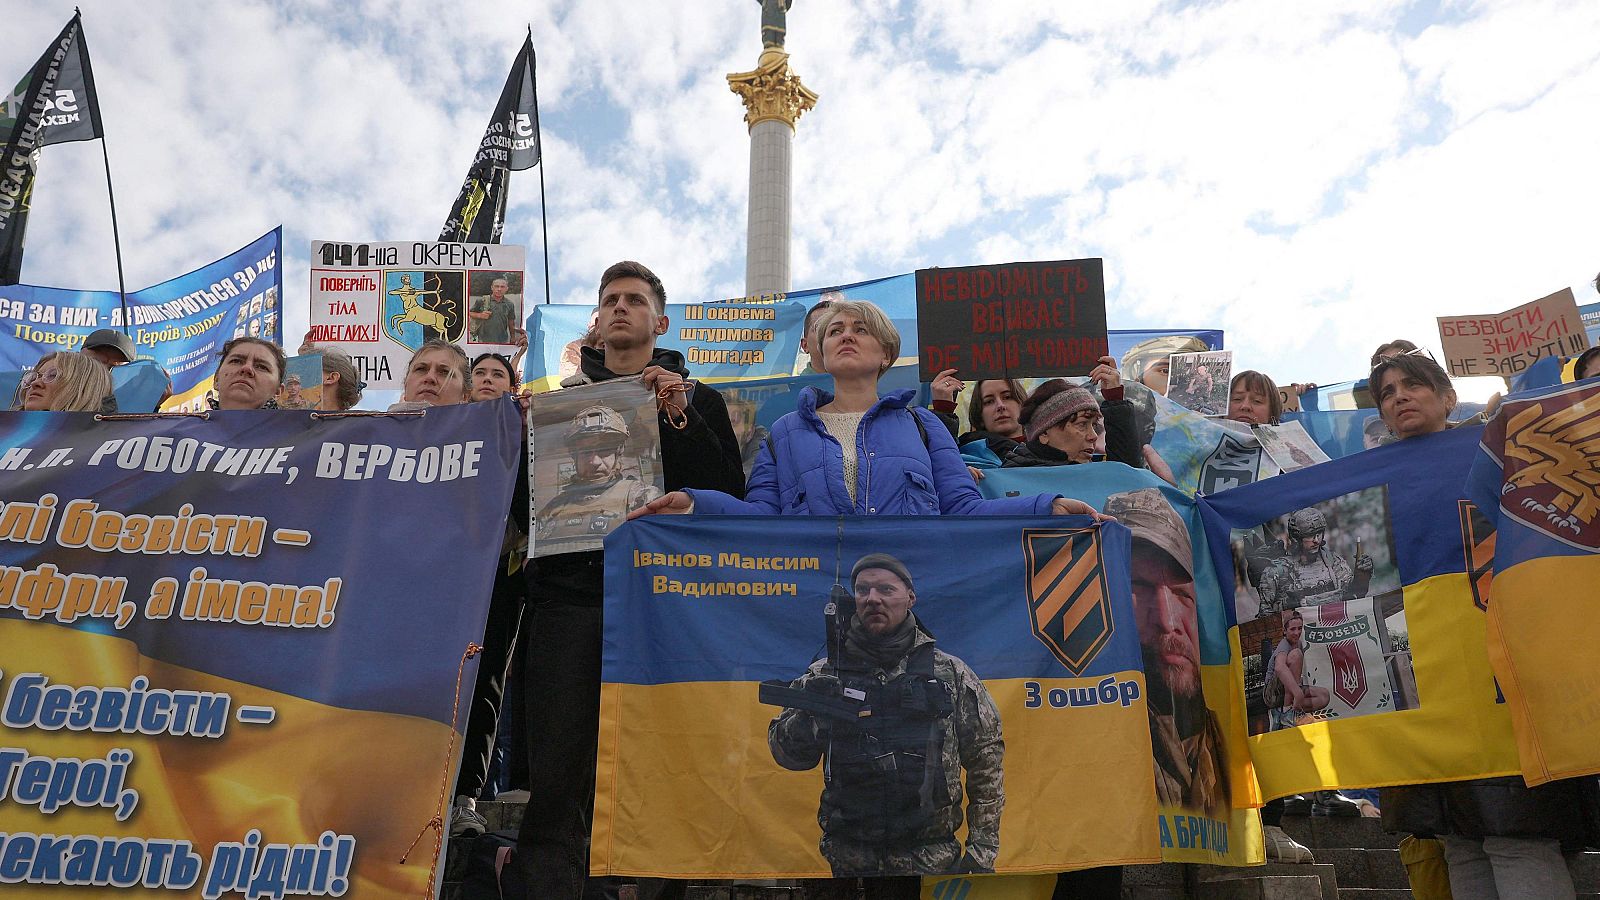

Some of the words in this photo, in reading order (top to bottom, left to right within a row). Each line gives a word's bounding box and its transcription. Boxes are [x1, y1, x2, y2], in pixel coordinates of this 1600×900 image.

[412, 242, 493, 267] ОКРЕМА
[28, 303, 56, 324] ЗА
[60, 306, 98, 327] НИХ
[156, 277, 240, 320] БОРЮТЬСЯ
[706, 306, 776, 322] окрема
[135, 324, 181, 348] Героїв
[680, 327, 775, 343] штурмова
[1441, 305, 1546, 338] БЕЗВІСТИ
[1482, 314, 1570, 356] ЗНИКЛІ
[350, 355, 393, 382] ТНА
[686, 345, 765, 366] бригада
[1451, 357, 1478, 376] НЕ
[87, 436, 300, 485] РОБОТИНЕ,
[315, 440, 485, 485] ВЕРБОВЕ
[0, 493, 58, 544] лі
[56, 498, 268, 558] безвісти
[633, 549, 713, 569] Іванов
[717, 552, 820, 571] Максим
[144, 576, 180, 621] а
[179, 567, 343, 629] імена!
[652, 575, 798, 599] Вадимович
[1, 671, 232, 738] безвісти
[1047, 676, 1141, 709] ошбр
[0, 831, 202, 890] екають
[201, 828, 357, 900] рідні!
